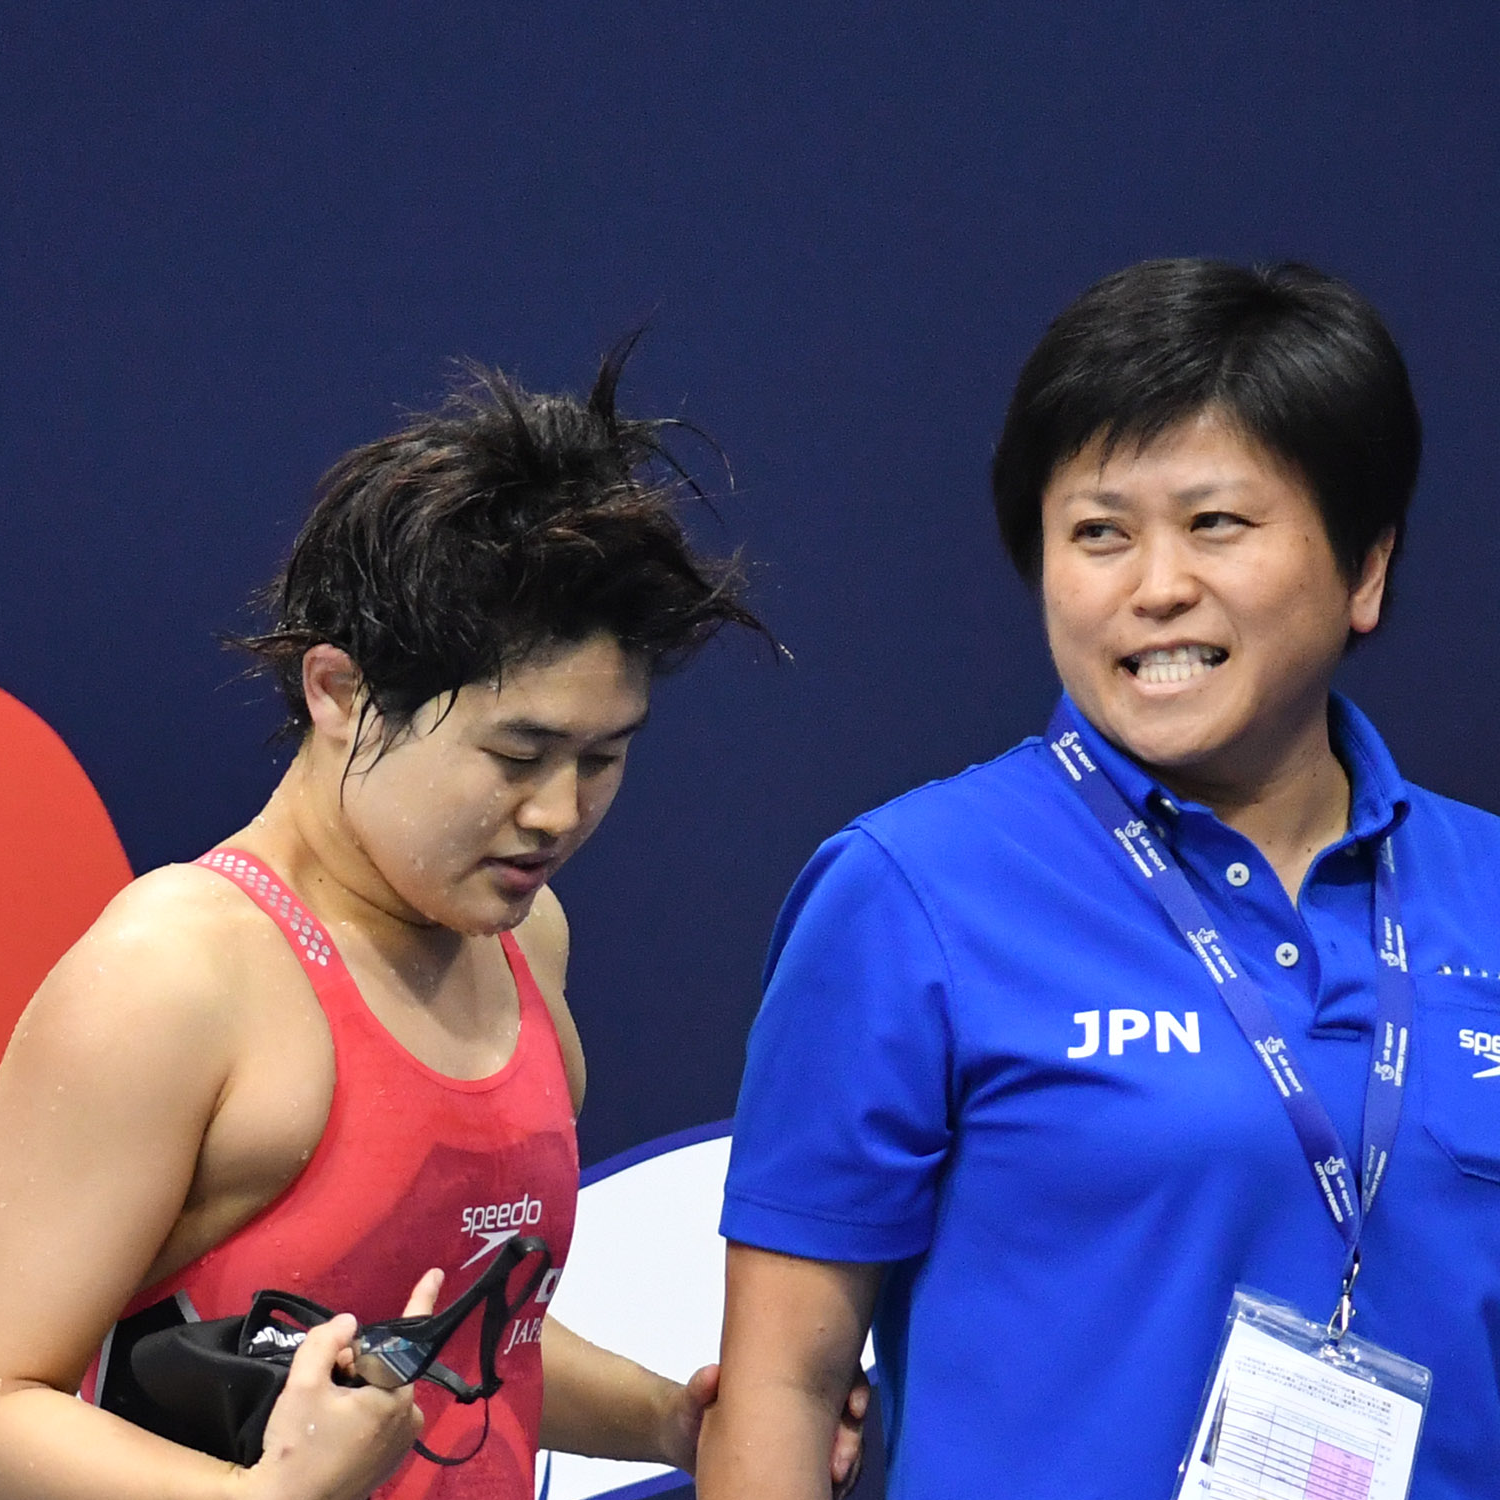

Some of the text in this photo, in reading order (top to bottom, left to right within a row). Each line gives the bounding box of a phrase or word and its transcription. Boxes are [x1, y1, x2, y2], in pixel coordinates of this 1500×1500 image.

[1114, 827, 1137, 856] LOTTERY
[1146, 847, 1167, 872] sport
[1187, 931, 1224, 984] LOTTERY FUNDED
[1217, 955, 1238, 979] sport
[1067, 1008, 1201, 1059] JPN
[1384, 1021, 1394, 1049] sport
[1254, 1040, 1276, 1070] LOTTERY
[1284, 1067, 1303, 1092] sport
[1314, 1161, 1344, 1223] LOTTERY FUNDED
[1341, 1189, 1354, 1217] sport
[461, 1193, 542, 1238] speedo
